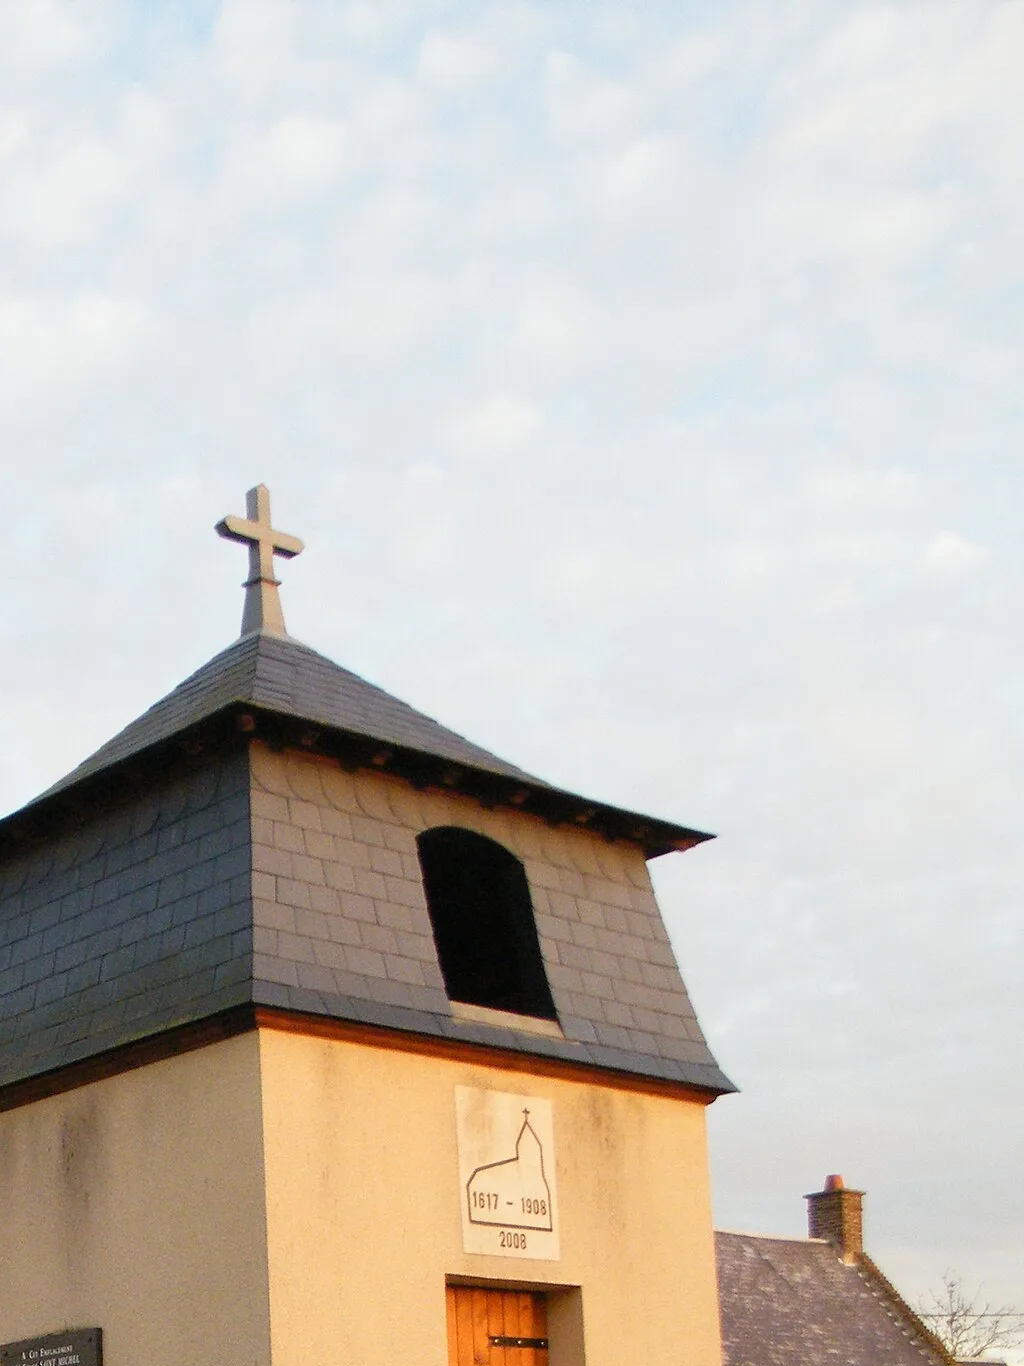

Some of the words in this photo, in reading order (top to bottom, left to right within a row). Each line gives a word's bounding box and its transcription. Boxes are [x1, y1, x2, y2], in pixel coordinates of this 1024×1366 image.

[472, 1191, 499, 1211] 1617
[521, 1197, 547, 1216] 1908
[500, 1231, 527, 1250] 2008
